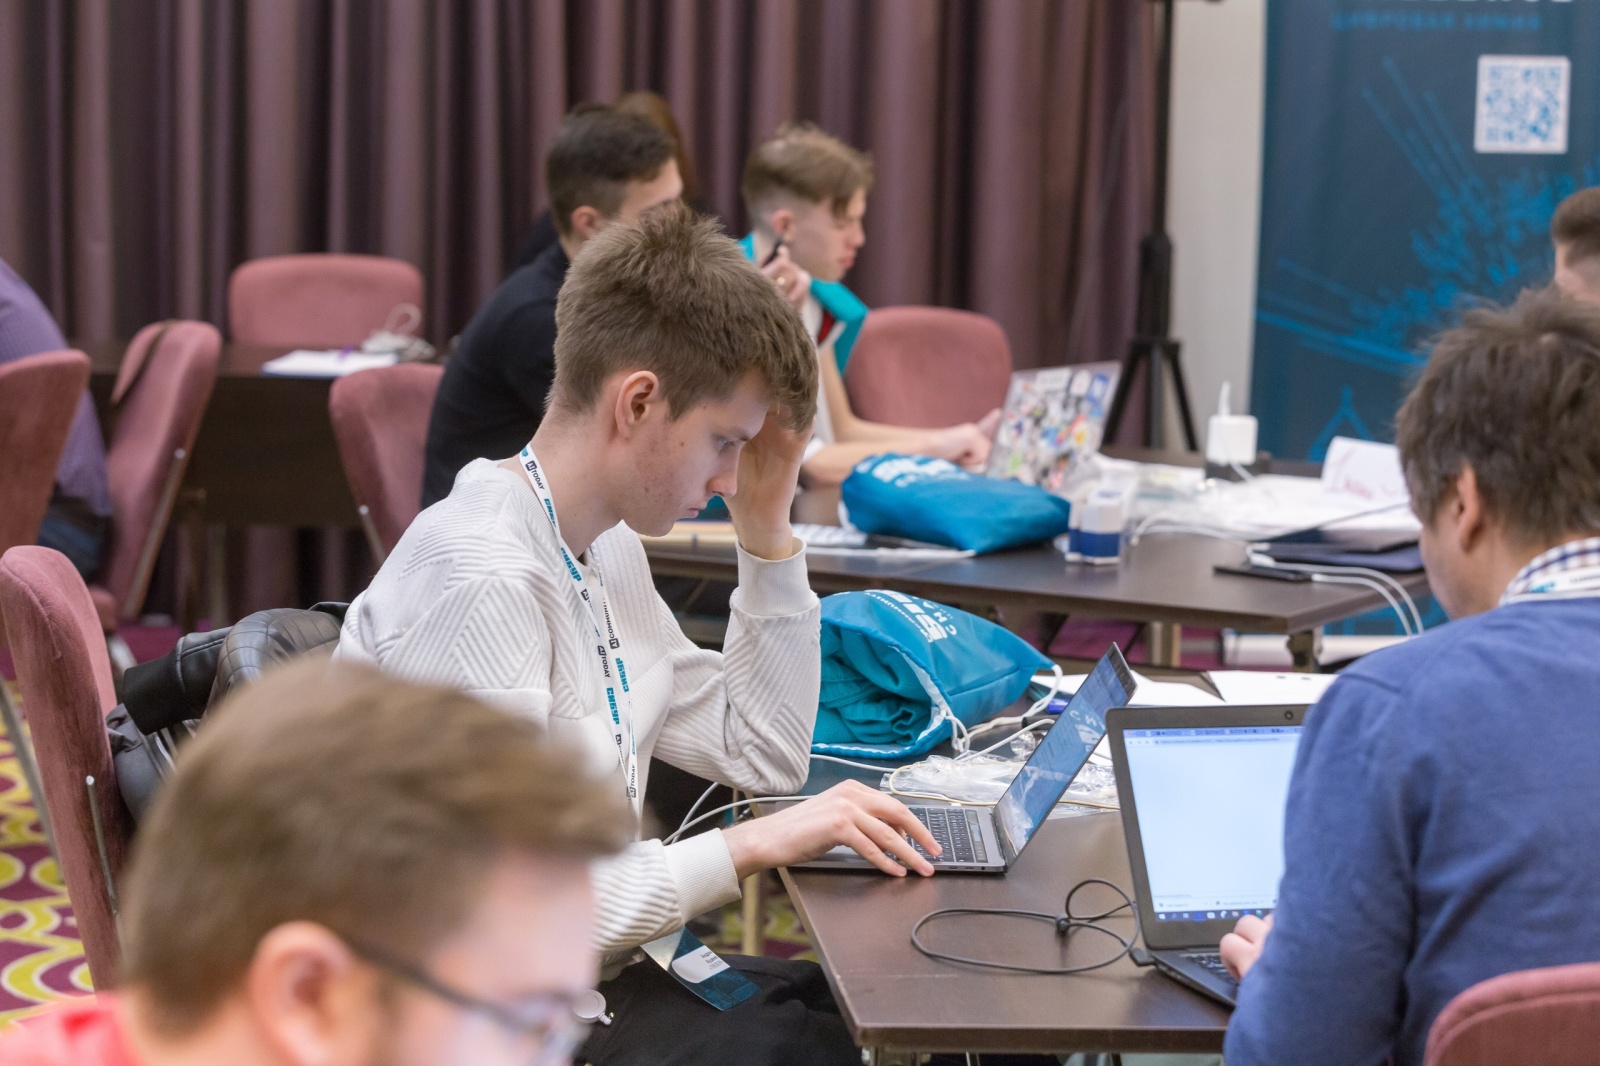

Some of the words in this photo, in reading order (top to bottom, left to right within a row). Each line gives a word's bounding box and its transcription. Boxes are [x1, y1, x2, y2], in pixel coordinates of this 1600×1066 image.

[532, 469, 545, 490] TODAY
[544, 498, 557, 527] СИБ
[603, 597, 615, 639] COMMUN
[601, 656, 611, 678] TODAY
[615, 657, 630, 693] СИБУР
[606, 687, 620, 725] СИБУР
